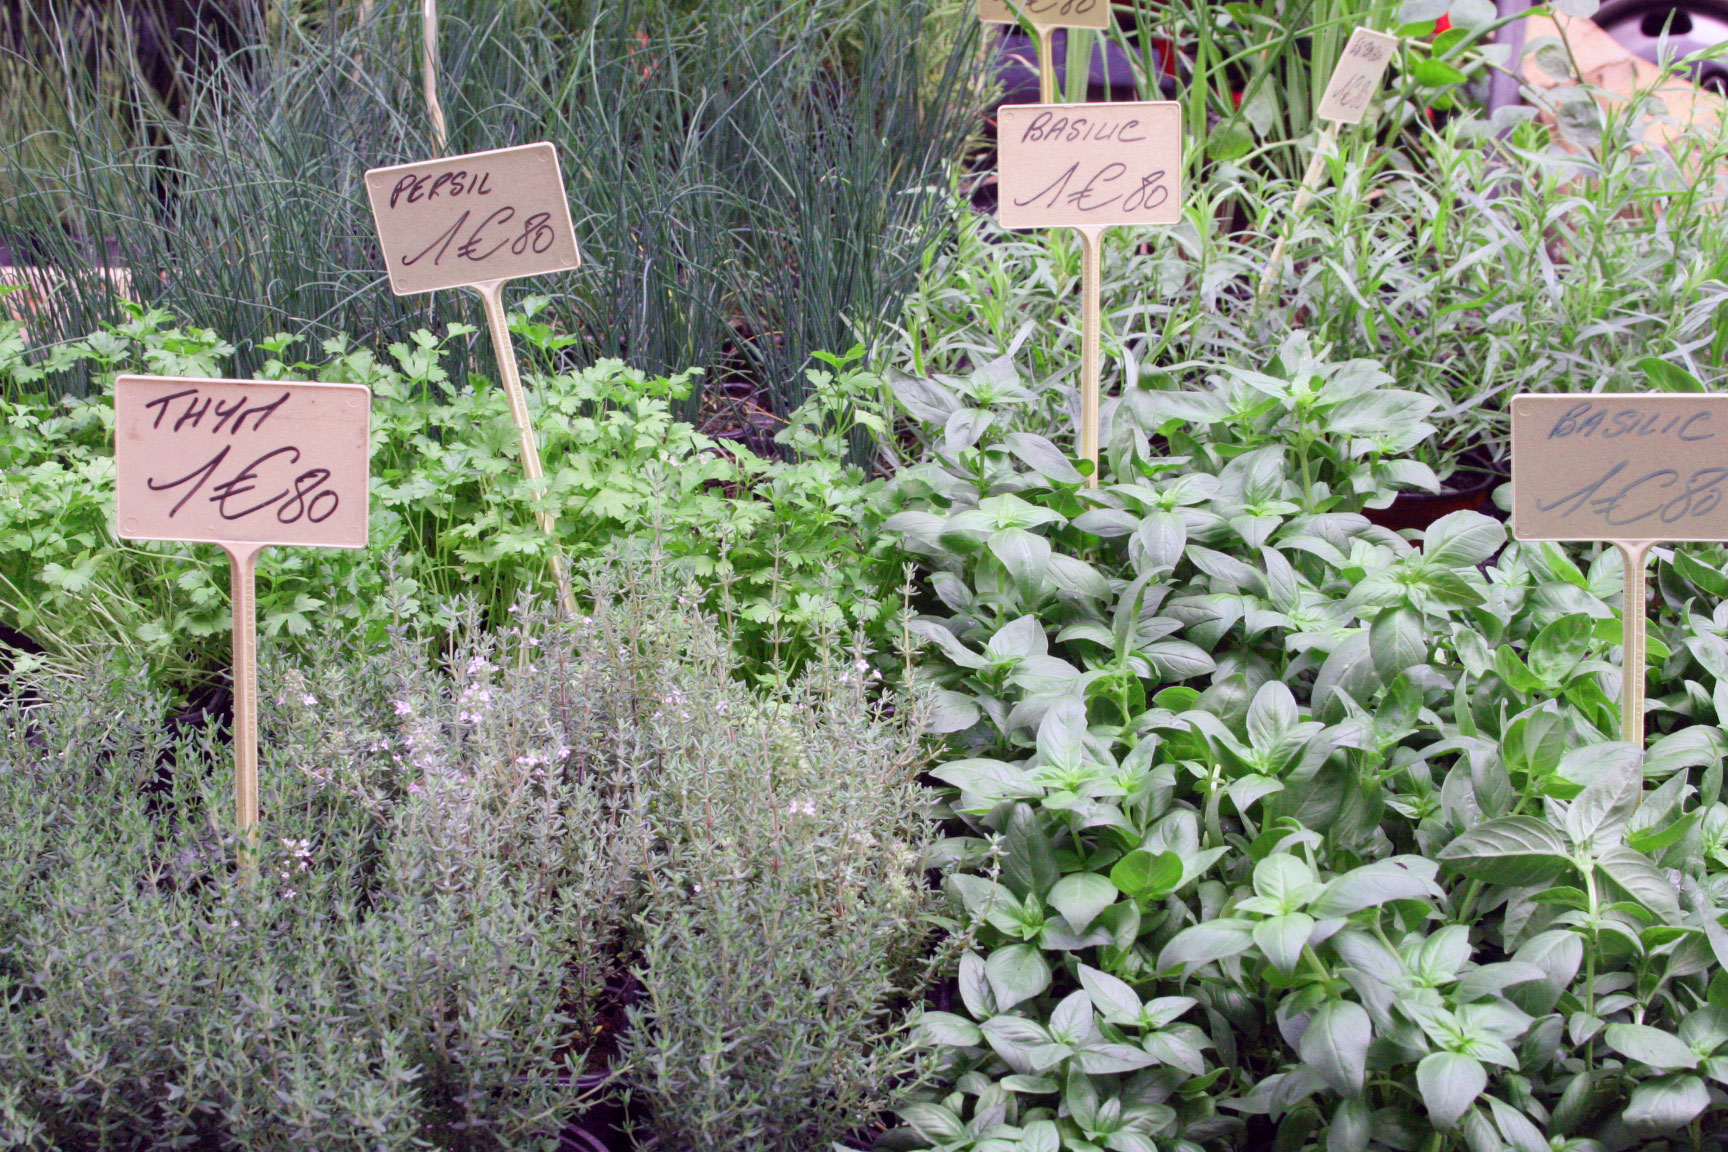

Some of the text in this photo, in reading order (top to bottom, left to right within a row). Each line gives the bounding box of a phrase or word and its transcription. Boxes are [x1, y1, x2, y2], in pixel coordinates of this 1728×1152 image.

[1021, 111, 1147, 143] BASILIC
[390, 170, 492, 209] PERSIL
[1013, 161, 1169, 212] 1€80
[402, 206, 555, 265] 1€80
[145, 388, 291, 435] THYM
[1546, 401, 1715, 441] BASILIC
[147, 444, 339, 524] 1€80
[1536, 459, 1728, 526] 1€80
